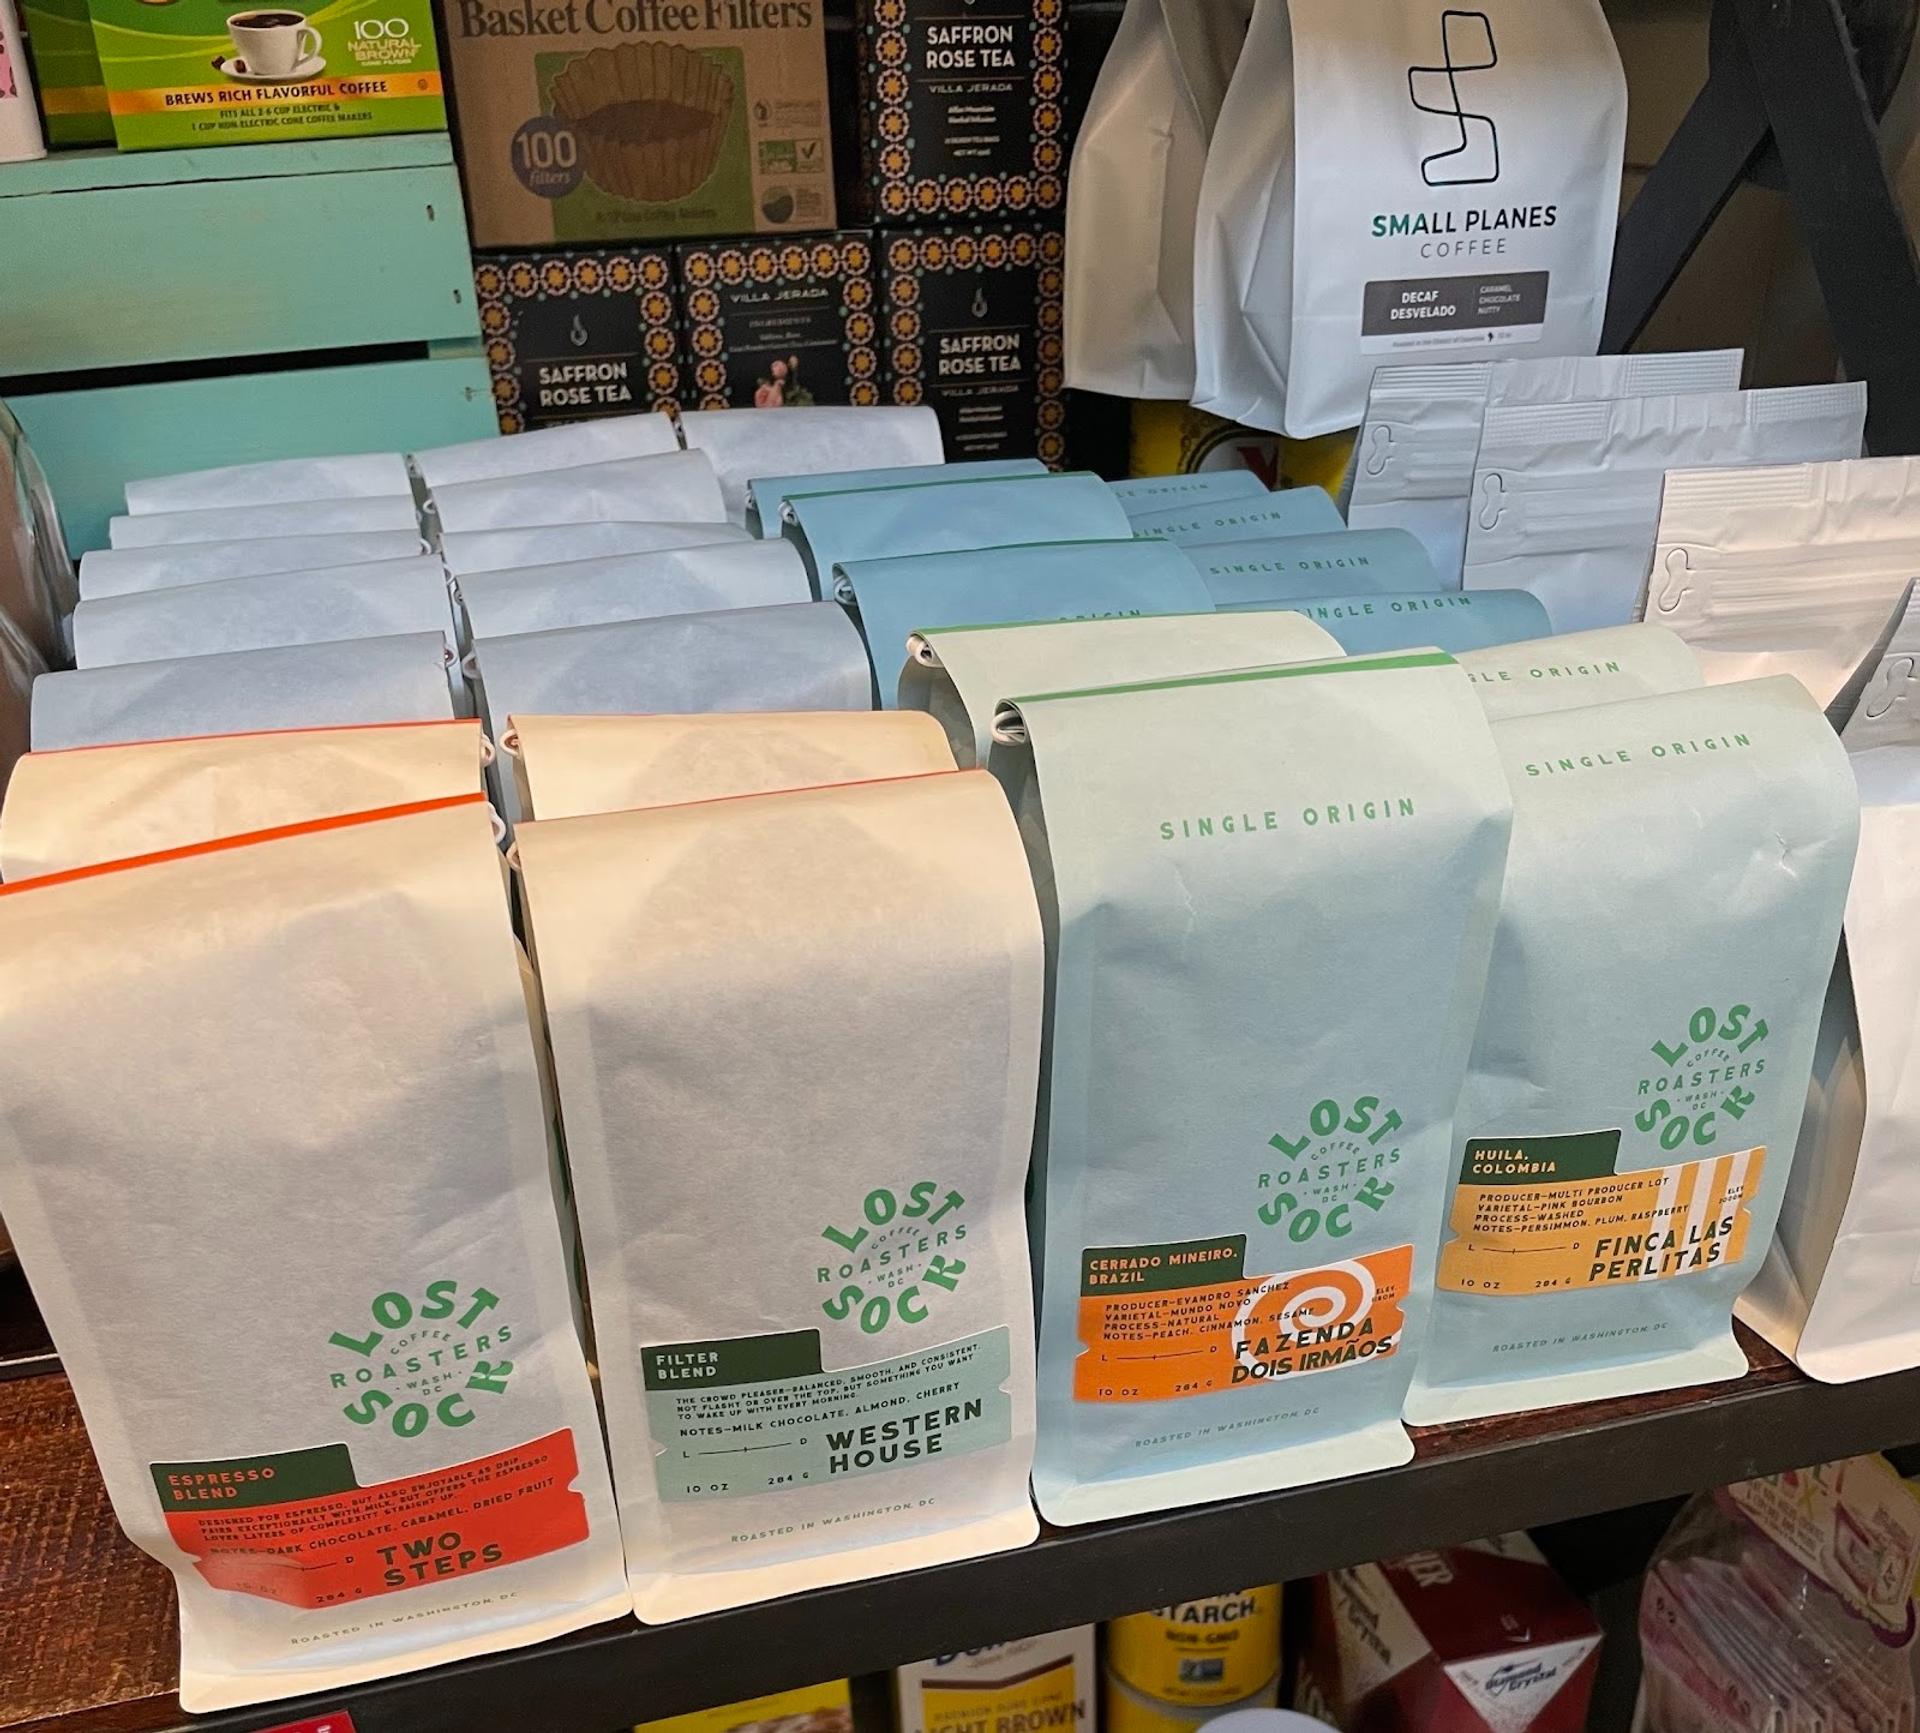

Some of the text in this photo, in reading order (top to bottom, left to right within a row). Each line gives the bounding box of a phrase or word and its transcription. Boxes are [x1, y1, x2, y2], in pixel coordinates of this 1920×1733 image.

[353, 18, 409, 39] 100
[461, 0, 813, 37] Basket Coffee Filters
[348, 37, 421, 51] NATURAL
[927, 25, 1013, 45] SAFFRON
[355, 48, 418, 61] BROWN
[926, 49, 1015, 69] ROSE TEA
[165, 81, 388, 106] BREWS RICH FLAVORFUL COFFEE
[928, 84, 963, 93] VILLA
[516, 131, 577, 168] 100
[529, 168, 571, 186] filters
[1371, 205, 1557, 237] SMALL PLANES
[1420, 238, 1507, 258] COFFEE
[1402, 290, 1440, 304] DECAF
[1479, 294, 1521, 304] CHOCOLATE
[1390, 304, 1457, 320] DESVELADO
[940, 334, 1020, 354] SAFFRON
[539, 362, 627, 385] SAFFRON
[939, 355, 1021, 376] ROSE TEA
[539, 384, 632, 407] ROSE TEA
[1214, 512, 1281, 527] ORIGIN
[1210, 556, 1370, 574] SINGLE ORIGIN
[1391, 597, 1471, 612] ORIGIN
[1530, 662, 1620, 678] ORIGIN
[1525, 733, 1753, 777] SINGLE ORIGIN
[1160, 798, 1416, 841] SINGLE ORIGIN
[1650, 1004, 1769, 1068] LOST
[1638, 1059, 1765, 1095] ROASTERS
[1268, 1096, 1403, 1161] LOST
[1635, 1085, 1755, 1150] SOCK
[1311, 1141, 1360, 1161] COFFEE
[1258, 1148, 1400, 1188] ROASTERS
[1473, 1162, 1556, 1174] COLOMBIA
[1587, 1177, 1670, 1195] PRODUCER LOT
[1258, 1177, 1395, 1242] SOCK
[1572, 1195, 1623, 1207] BOURBON
[821, 1181, 965, 1253] LOST
[1631, 1205, 1689, 1221] RASPBERRY
[1595, 1216, 1733, 1258] FINCA LAS
[817, 1224, 966, 1283] ROASTERS
[1090, 1257, 1161, 1271] CERRADO
[1588, 1242, 1720, 1282] PERLITAS
[887, 1279, 904, 1288] DC
[1089, 1271, 1145, 1285] BRAZIL
[1483, 1281, 1500, 1289] OZ
[822, 1254, 966, 1334] SOCK
[1237, 1282, 1290, 1298] SANCHEZ
[1219, 1298, 1251, 1310] NOVO
[328, 1280, 500, 1357] LOST
[390, 1330, 453, 1355] COFFEE
[1235, 1317, 1373, 1360] FAZENDA
[1493, 1340, 1547, 1353] ROASTED
[1653, 1322, 1669, 1331] DC
[330, 1326, 512, 1388] ROASTERS
[656, 1352, 719, 1366] FILTER
[1232, 1337, 1393, 1383] DOIS IRMÃOS
[406, 1372, 452, 1389] WASH
[657, 1366, 717, 1380] BLEND
[700, 1393, 736, 1402] CROWD
[899, 1362, 917, 1372] AND
[702, 1401, 740, 1411] FLASHY
[745, 1399, 759, 1407] OR
[764, 1395, 789, 1405] OVER
[794, 1392, 812, 1400] THE
[843, 1383, 862, 1391] BUT
[866, 1370, 921, 1387] SOMETHING
[925, 1363, 944, 1373] YOU
[948, 1353, 974, 1366] WANT
[342, 1361, 514, 1438] SOCK
[422, 1386, 442, 1396] DC
[916, 1381, 960, 1400] CHERRY
[1122, 1388, 1139, 1396] OZ
[698, 1411, 725, 1419] WAKE
[747, 1405, 772, 1414] WITH
[777, 1400, 806, 1410] EVERY
[826, 1398, 982, 1450] WESTERN
[1135, 1407, 1320, 1447] ROASTED IN DC
[829, 1433, 942, 1473] HOUSE
[168, 1468, 274, 1486] ESPRESSO
[173, 1486, 238, 1501] BLEND
[199, 1466, 491, 1527] DESIGNED FOR BUT ALSO ENJOYABLE AS
[237, 1515, 326, 1533] EXCEPTIONALLY
[331, 1510, 361, 1519] WITH
[400, 1494, 420, 1503] BUT
[425, 1482, 466, 1497] OFFERS
[471, 1475, 491, 1485] THE
[496, 1455, 548, 1478] ESPRESSO
[473, 1477, 554, 1509] DRIED FRUIT
[244, 1530, 285, 1540] LAYERS
[291, 1527, 303, 1535] OF
[385, 1496, 435, 1515] STRAIGHT
[731, 1497, 936, 1543] ROASTED IN DC
[377, 1532, 461, 1565] TWO
[384, 1543, 503, 1587] STEPS
[291, 1626, 360, 1644] ROASTED
[500, 1592, 517, 1600] DC
